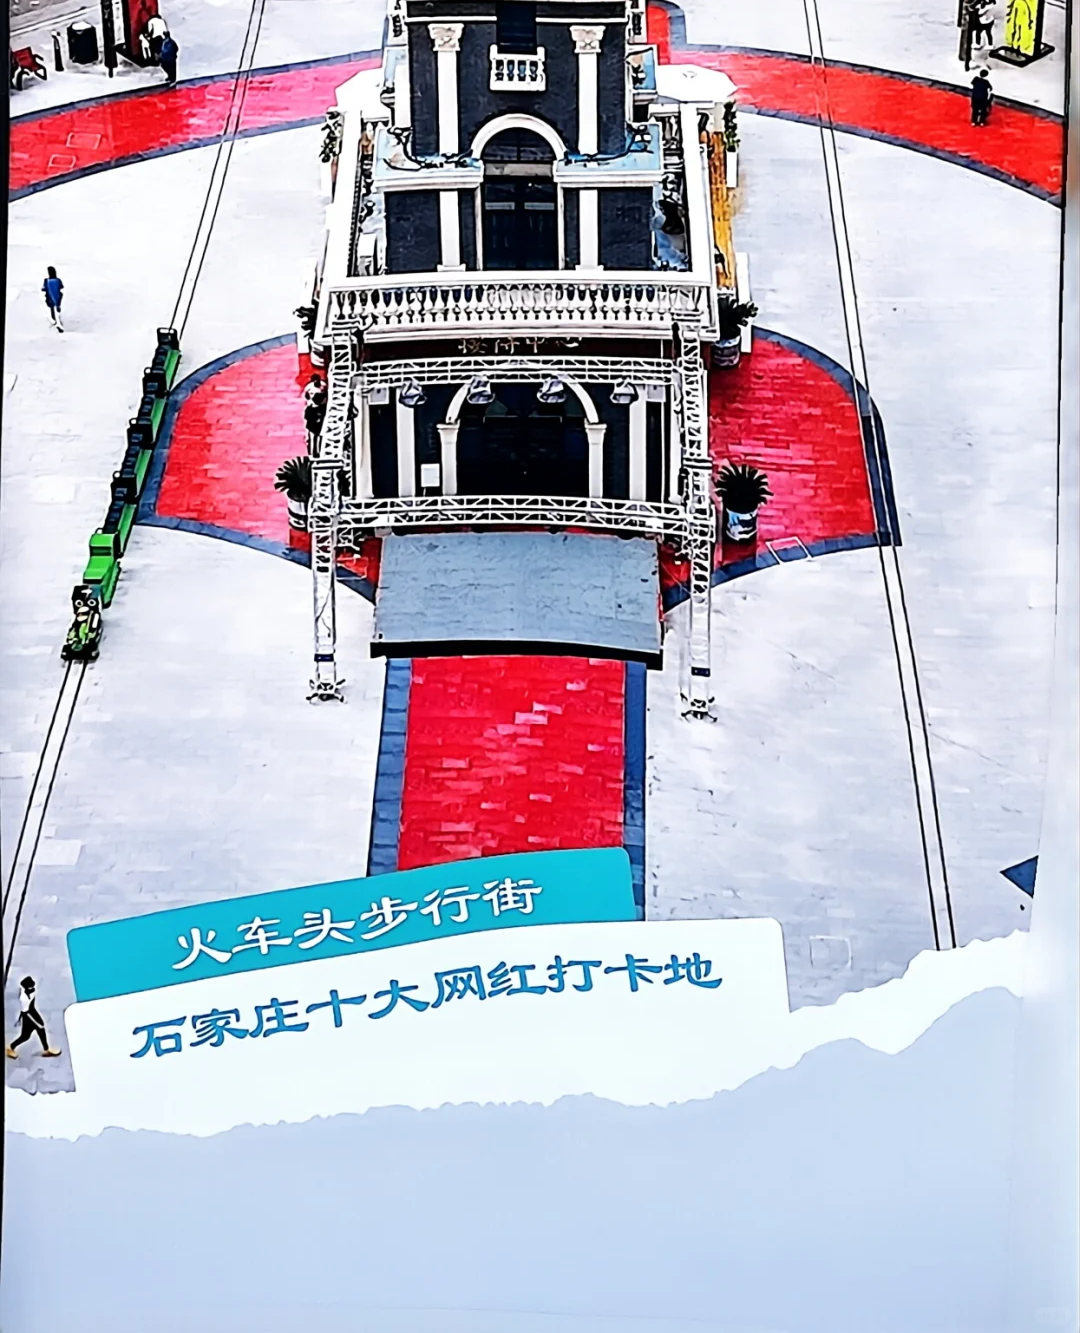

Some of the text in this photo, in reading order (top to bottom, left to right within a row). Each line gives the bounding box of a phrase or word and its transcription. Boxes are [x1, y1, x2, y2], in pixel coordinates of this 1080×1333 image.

[171, 876, 544, 971] 火车头步行街
[129, 952, 724, 1059] 石家庄十大网红打卡地
